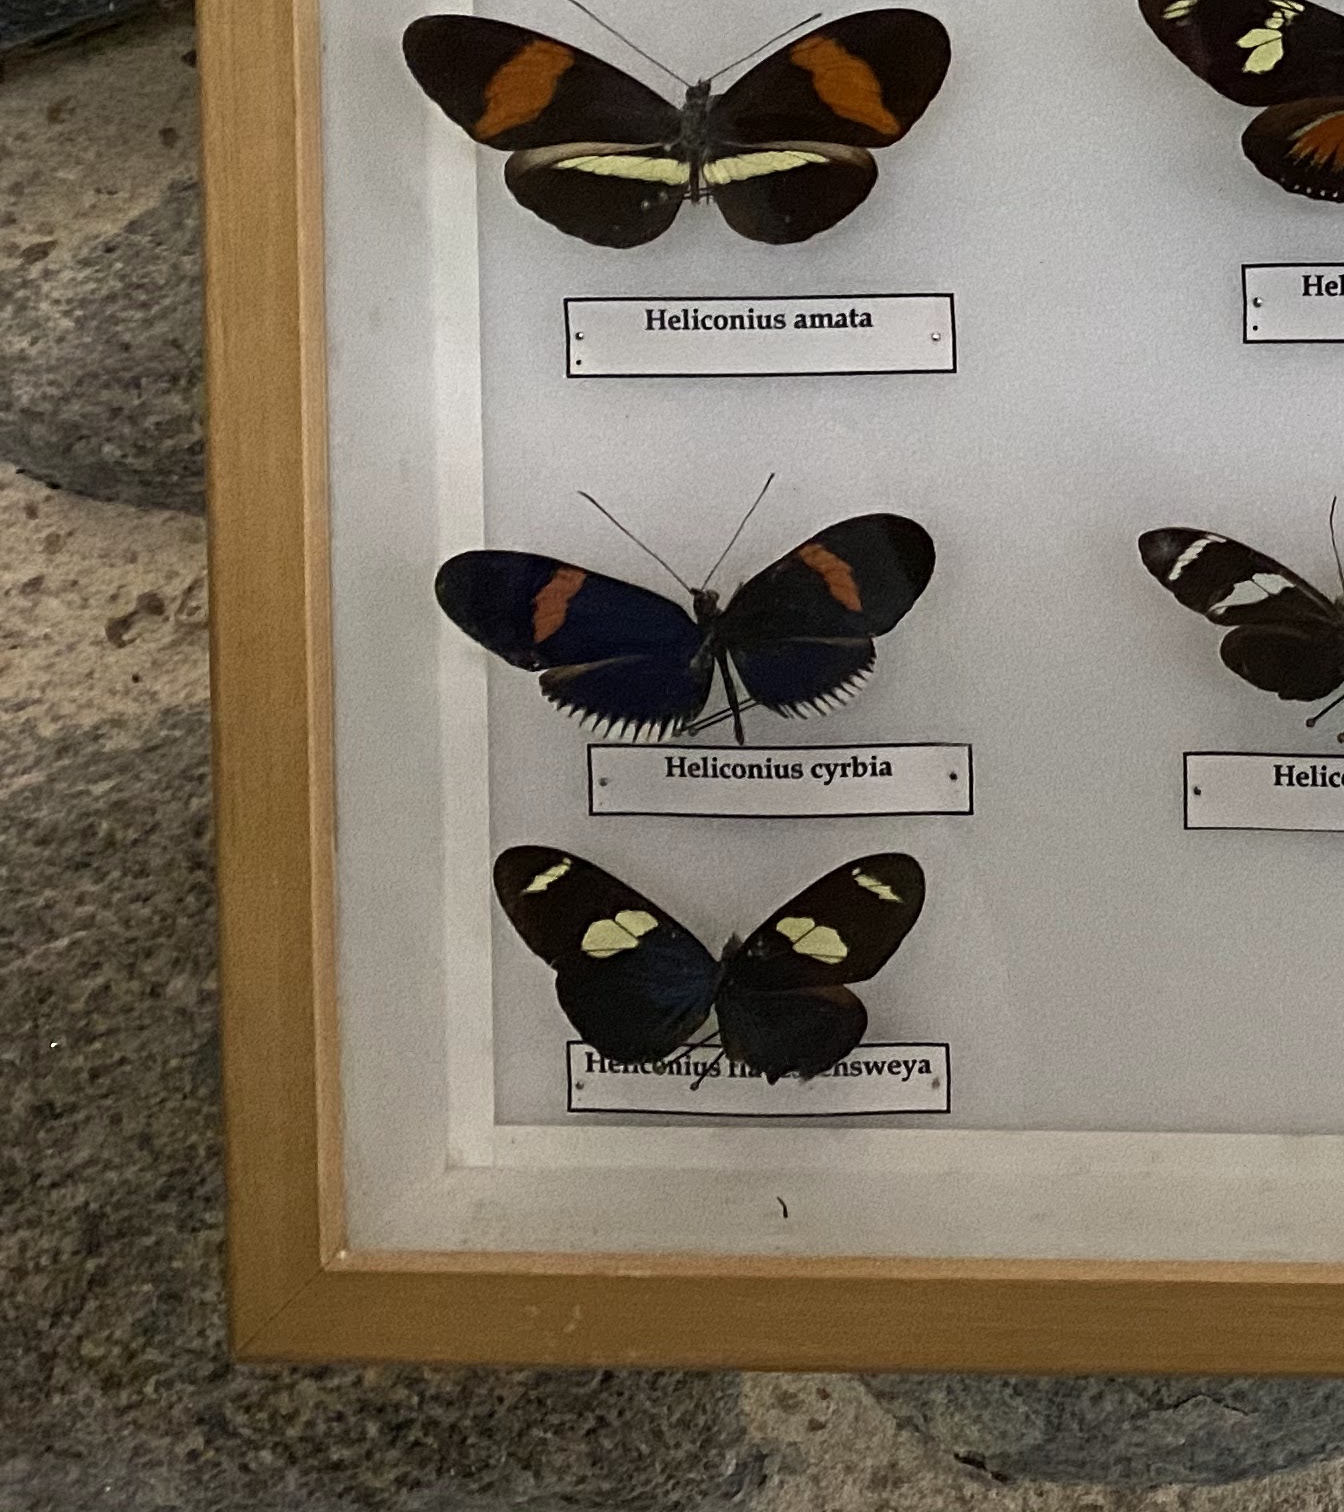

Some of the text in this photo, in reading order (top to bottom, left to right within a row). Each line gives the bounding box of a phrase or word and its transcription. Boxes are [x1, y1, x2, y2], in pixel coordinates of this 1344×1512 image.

[644, 307, 873, 331] Heliconius amata
[664, 755, 894, 786] Heliconius cyrbia
